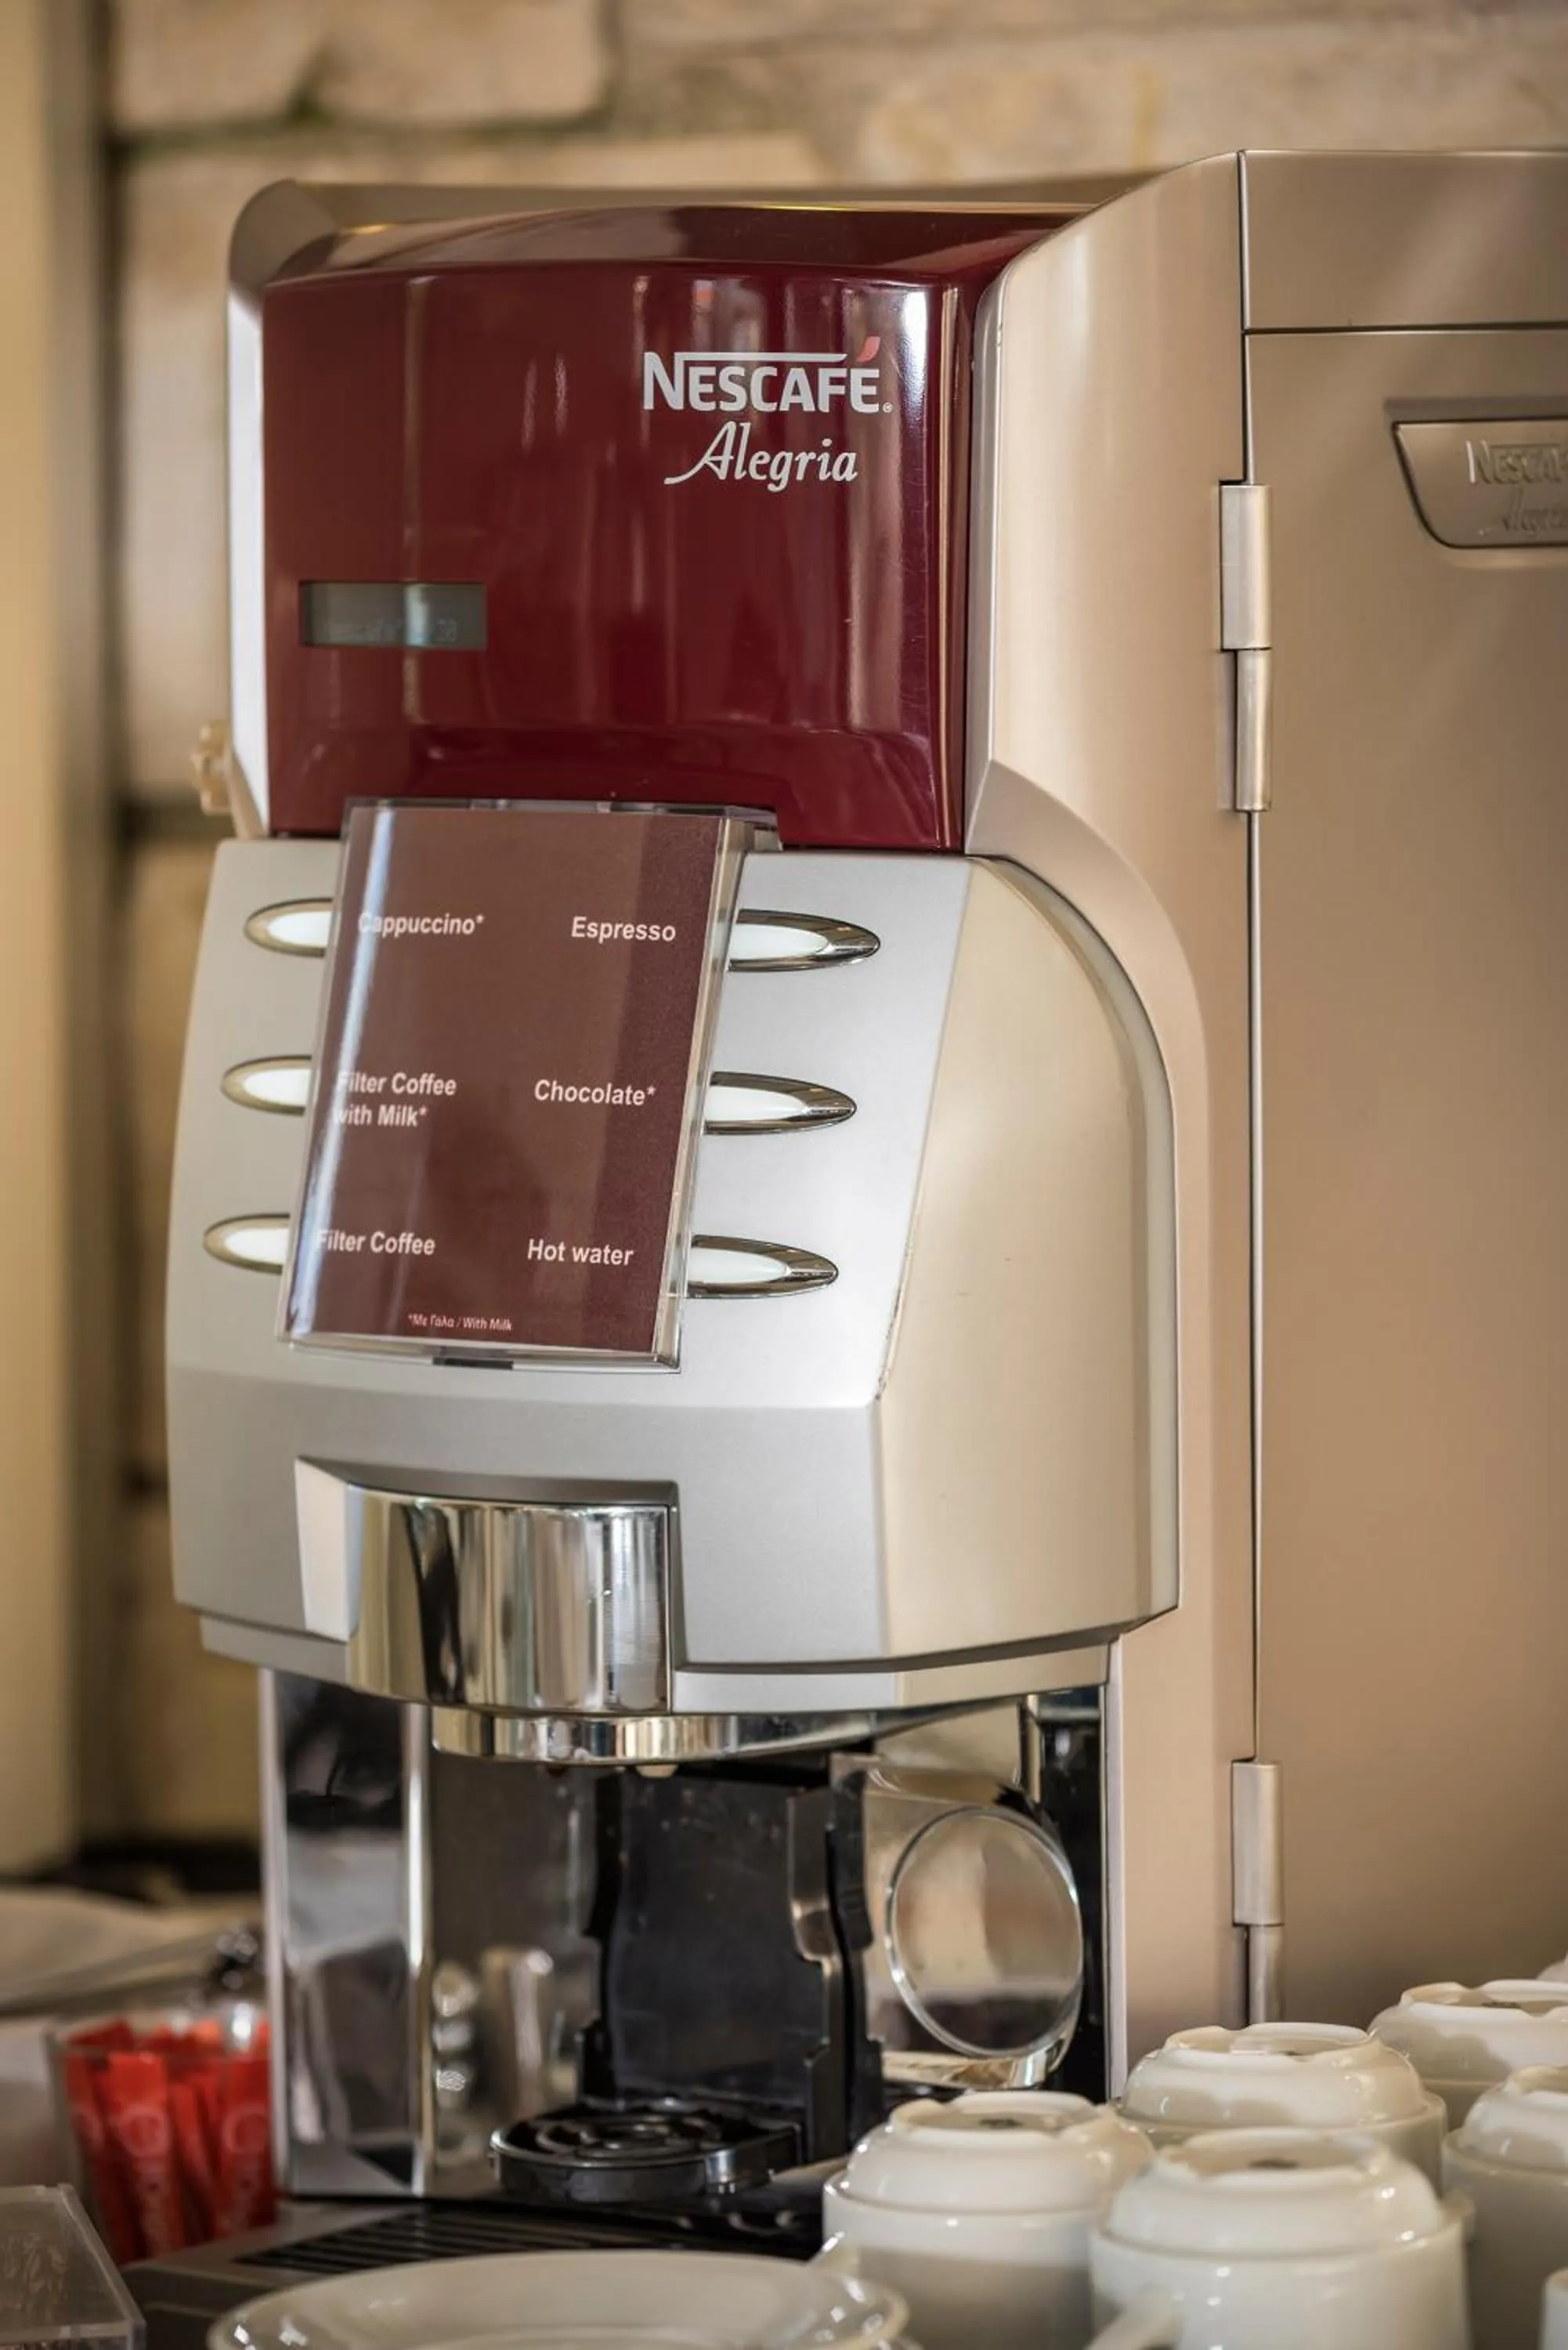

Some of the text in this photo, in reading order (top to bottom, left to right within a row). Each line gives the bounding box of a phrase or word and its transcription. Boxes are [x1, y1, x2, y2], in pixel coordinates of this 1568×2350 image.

[663, 421, 858, 494] Alegria
[571, 915, 677, 944] Espresso
[391, 1072, 457, 1096] Coffee
[370, 1231, 436, 1256] Coffee
[526, 1238, 635, 1266] Hot water
[463, 1317, 487, 1330] With
[489, 1318, 513, 1332] Milk
